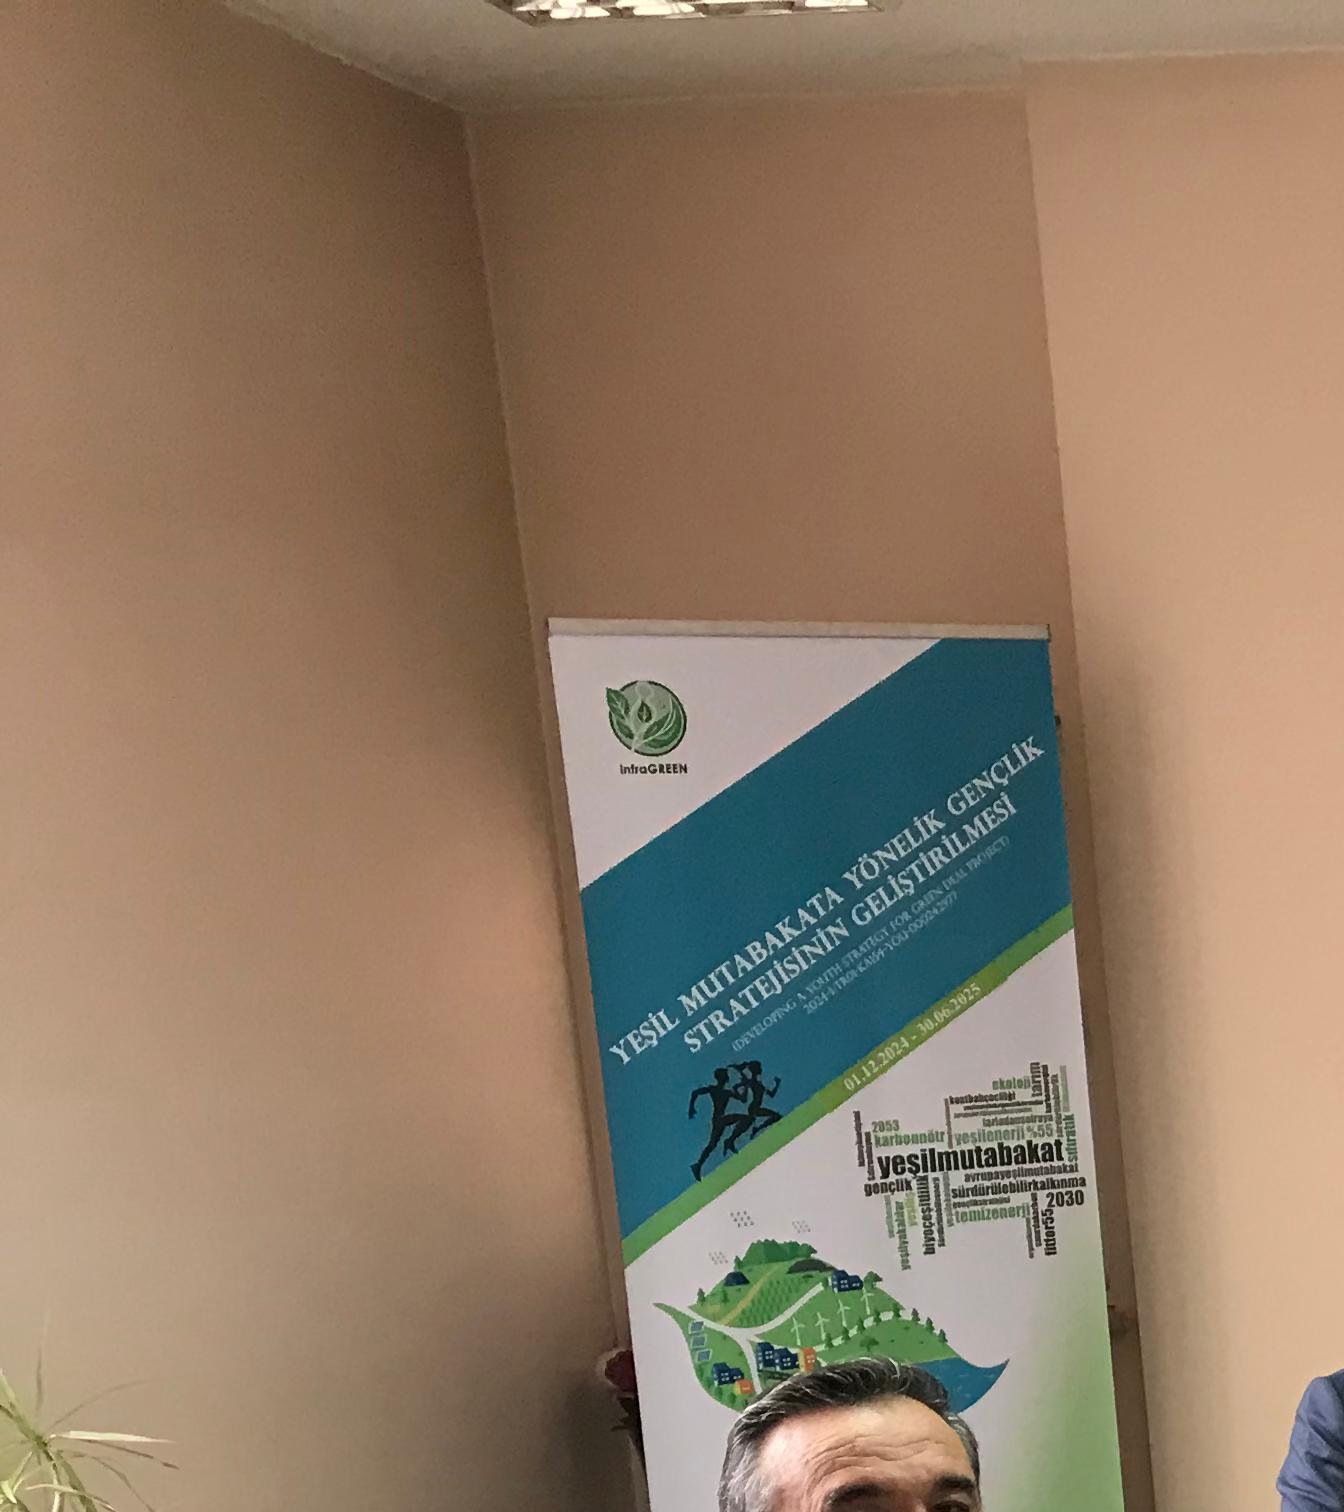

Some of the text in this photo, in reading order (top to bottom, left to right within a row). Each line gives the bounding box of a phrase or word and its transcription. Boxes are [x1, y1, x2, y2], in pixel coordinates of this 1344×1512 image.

[619, 763, 688, 775] infraGREEN
[609, 736, 1045, 1065] YEŞİL MUTABAKATA YÖNELİK GENÇLİK
[683, 791, 1018, 1053] STRATEJİSİNİN GELİŞTİRİLMESİ
[844, 1036, 910, 1091] 01.12.2024
[917, 981, 982, 1036] 30.06.2025
[877, 1139, 1065, 1179] yeşilmutabakat
[863, 1179, 913, 1197] gençlik
[1045, 1189, 1085, 1208] 2030
